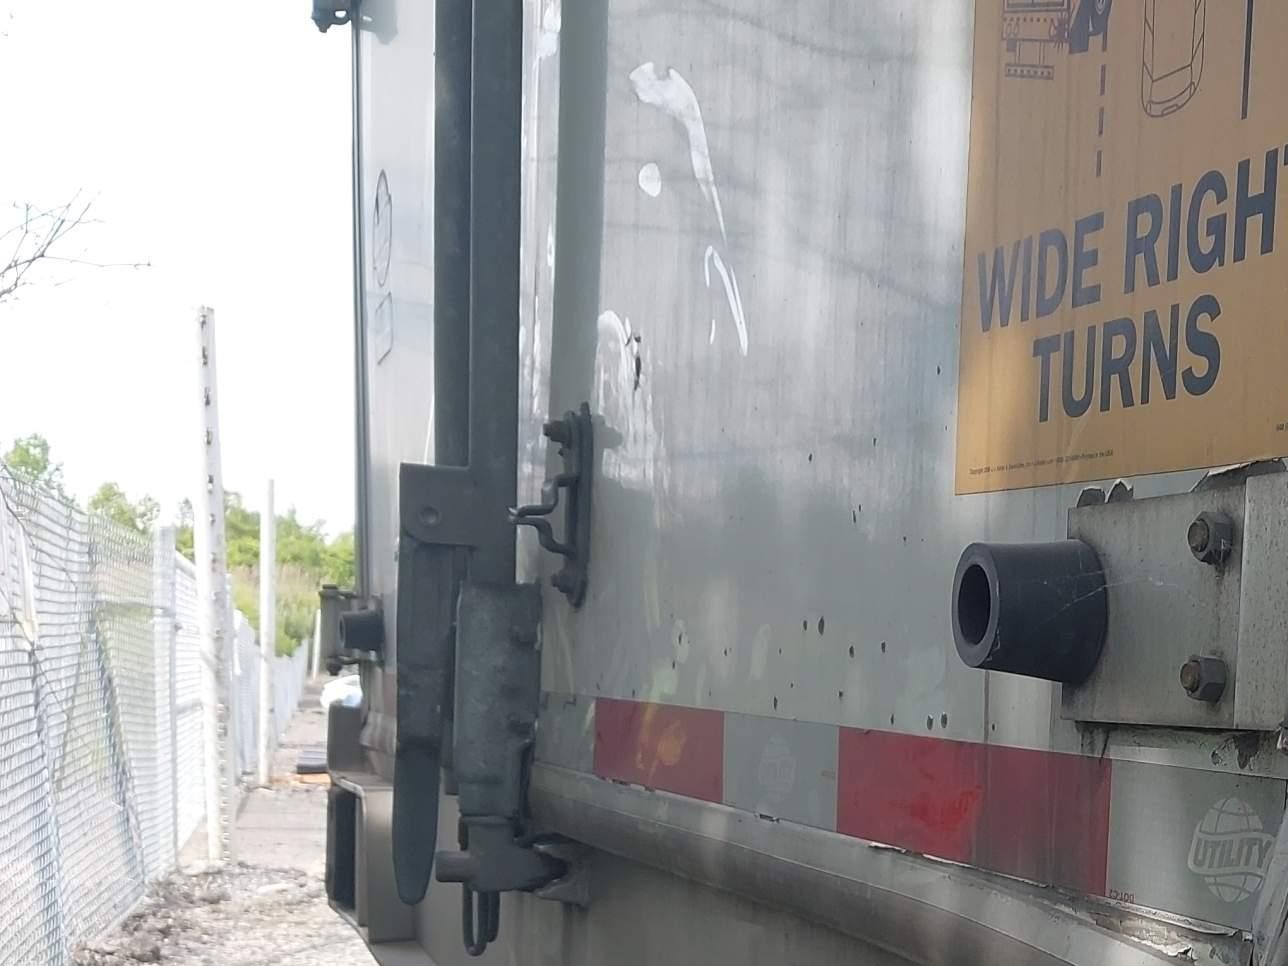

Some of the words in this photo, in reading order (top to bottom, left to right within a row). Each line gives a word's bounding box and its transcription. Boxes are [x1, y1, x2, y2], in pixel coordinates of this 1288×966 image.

[977, 211, 1104, 333] WIDE
[1032, 294, 1222, 424] TURNS
[1193, 838, 1272, 869] UTILITY
